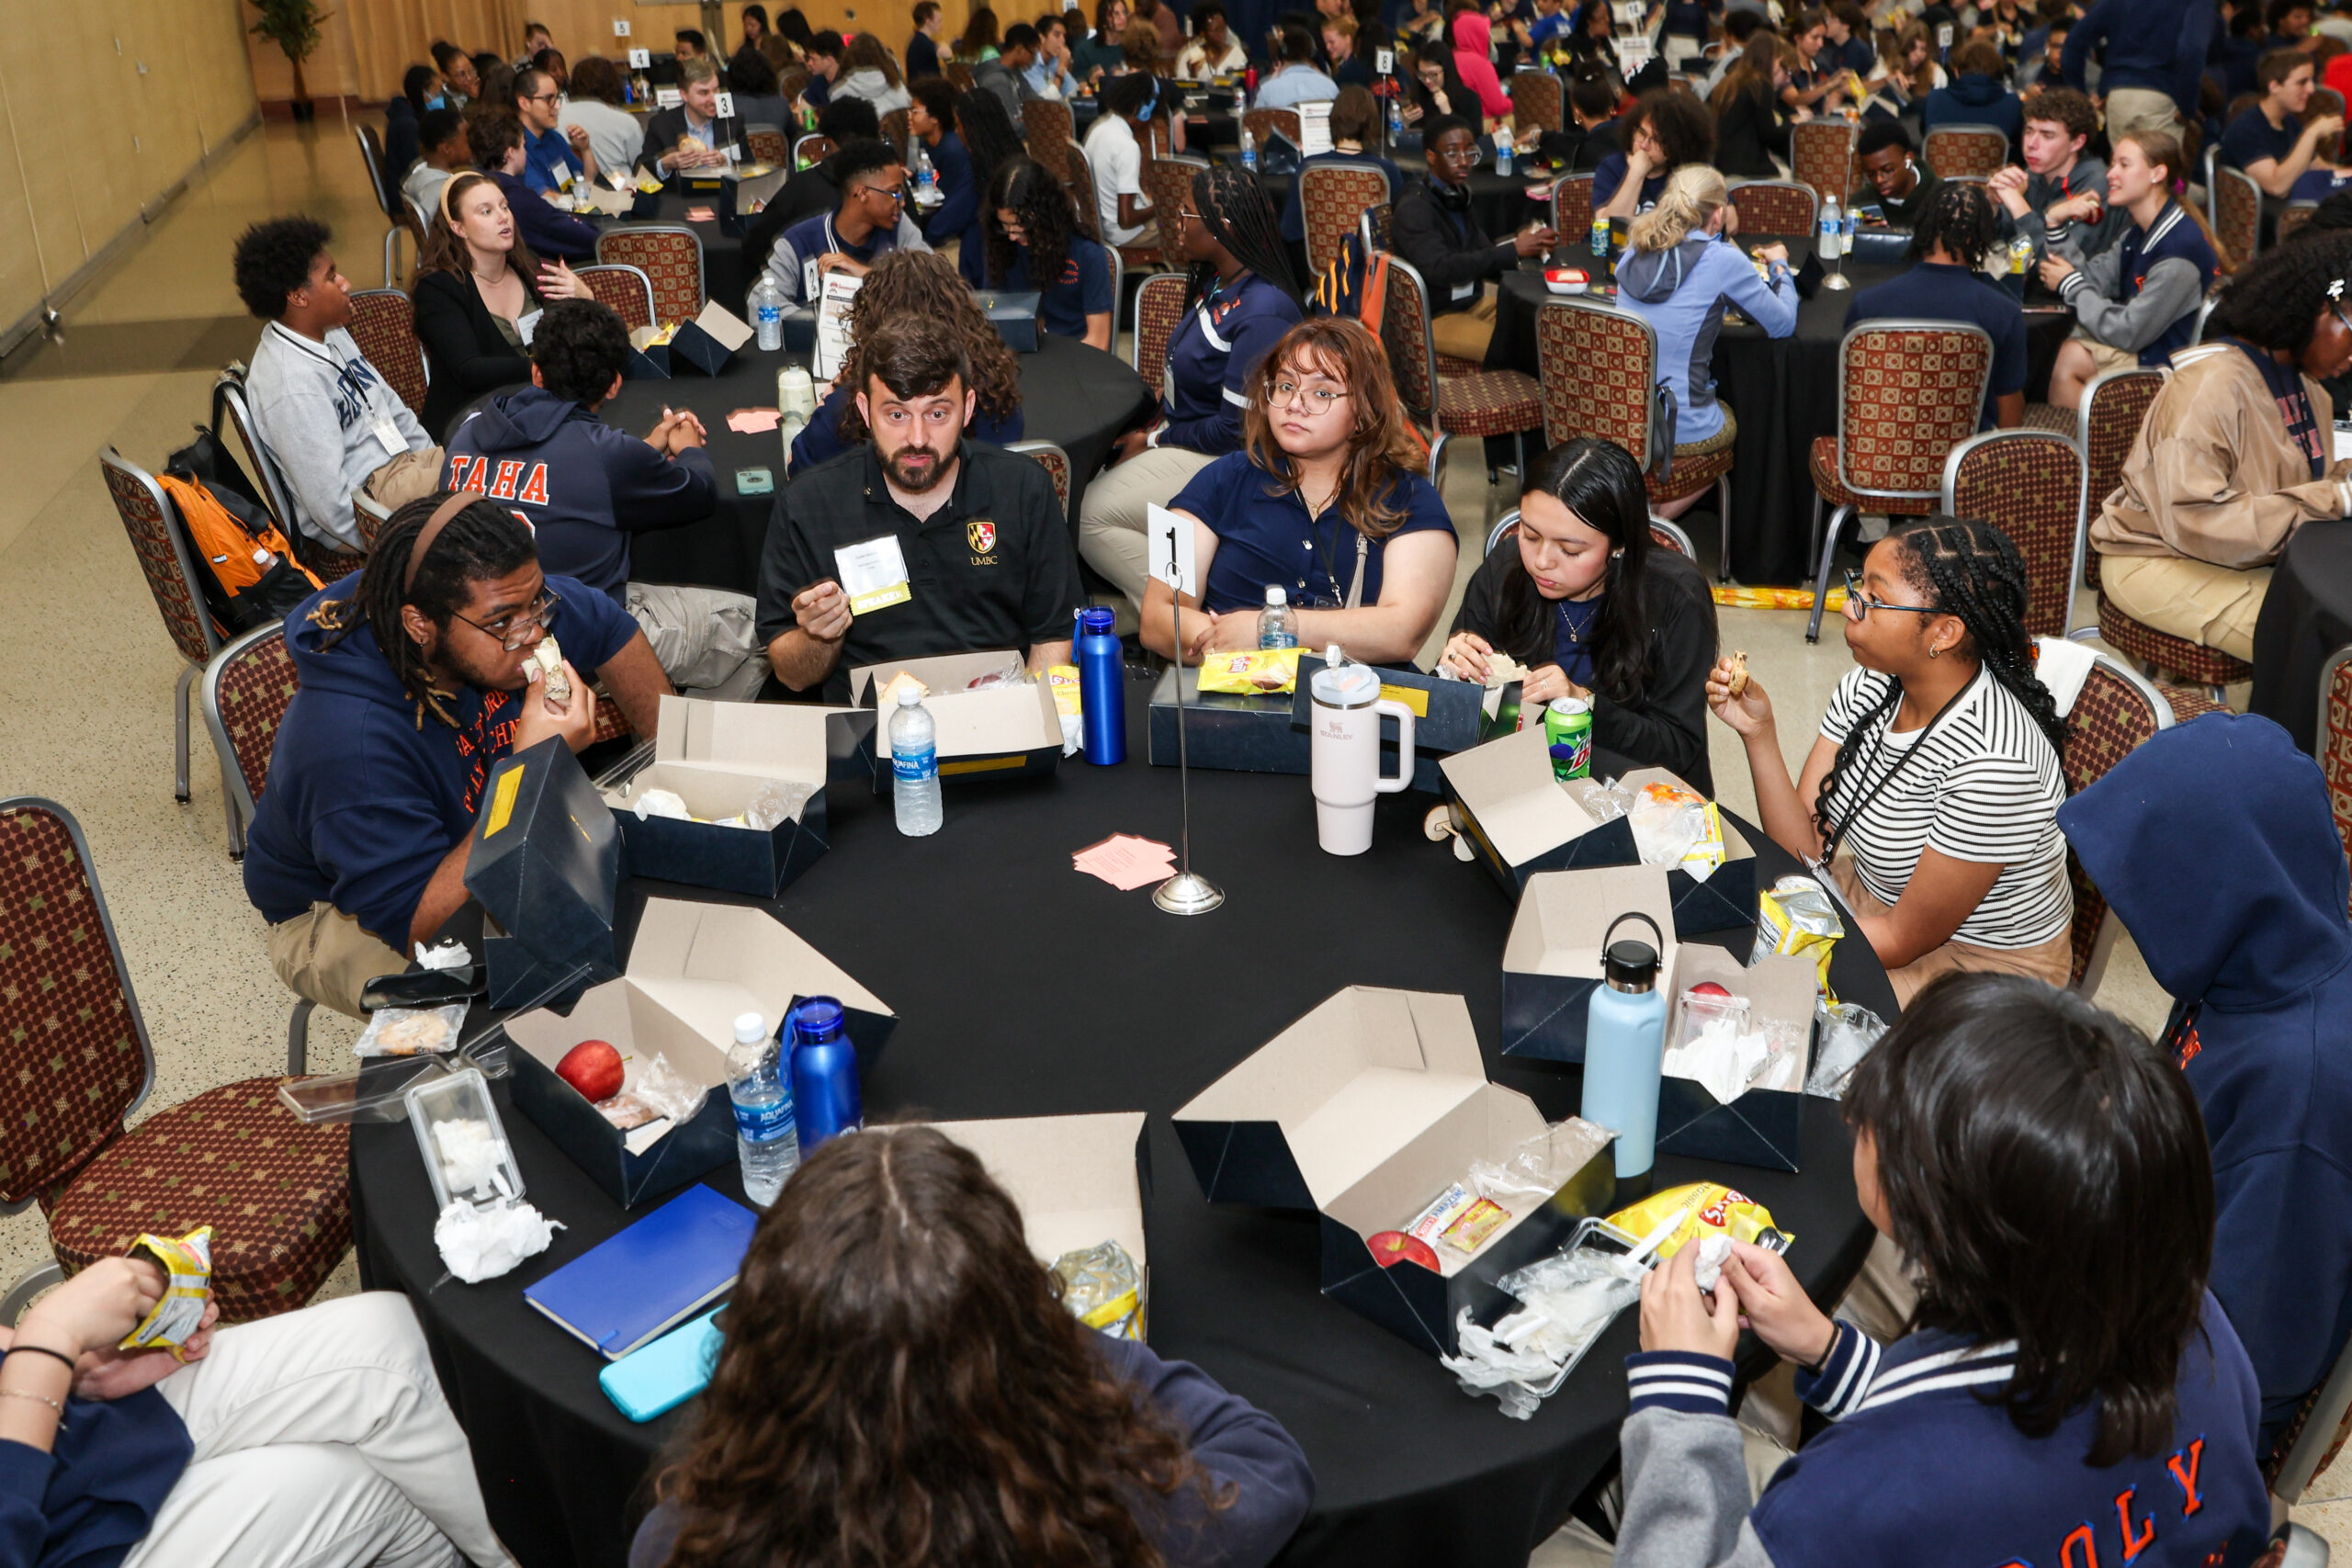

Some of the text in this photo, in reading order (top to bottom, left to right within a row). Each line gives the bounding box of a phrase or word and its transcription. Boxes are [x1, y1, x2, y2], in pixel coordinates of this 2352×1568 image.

[637, 53, 643, 65] 4
[1382, 55, 1389, 70] 8
[720, 97, 729, 113] 3
[809, 267, 818, 292] 2
[448, 456, 549, 506] TAHA
[1166, 526, 1177, 576] 1
[970, 556, 999, 566] UMBC
[855, 590, 904, 611] SPEAKER
[1320, 729, 1353, 741] STANLEY
[1997, 1433, 2205, 1568] OLY
